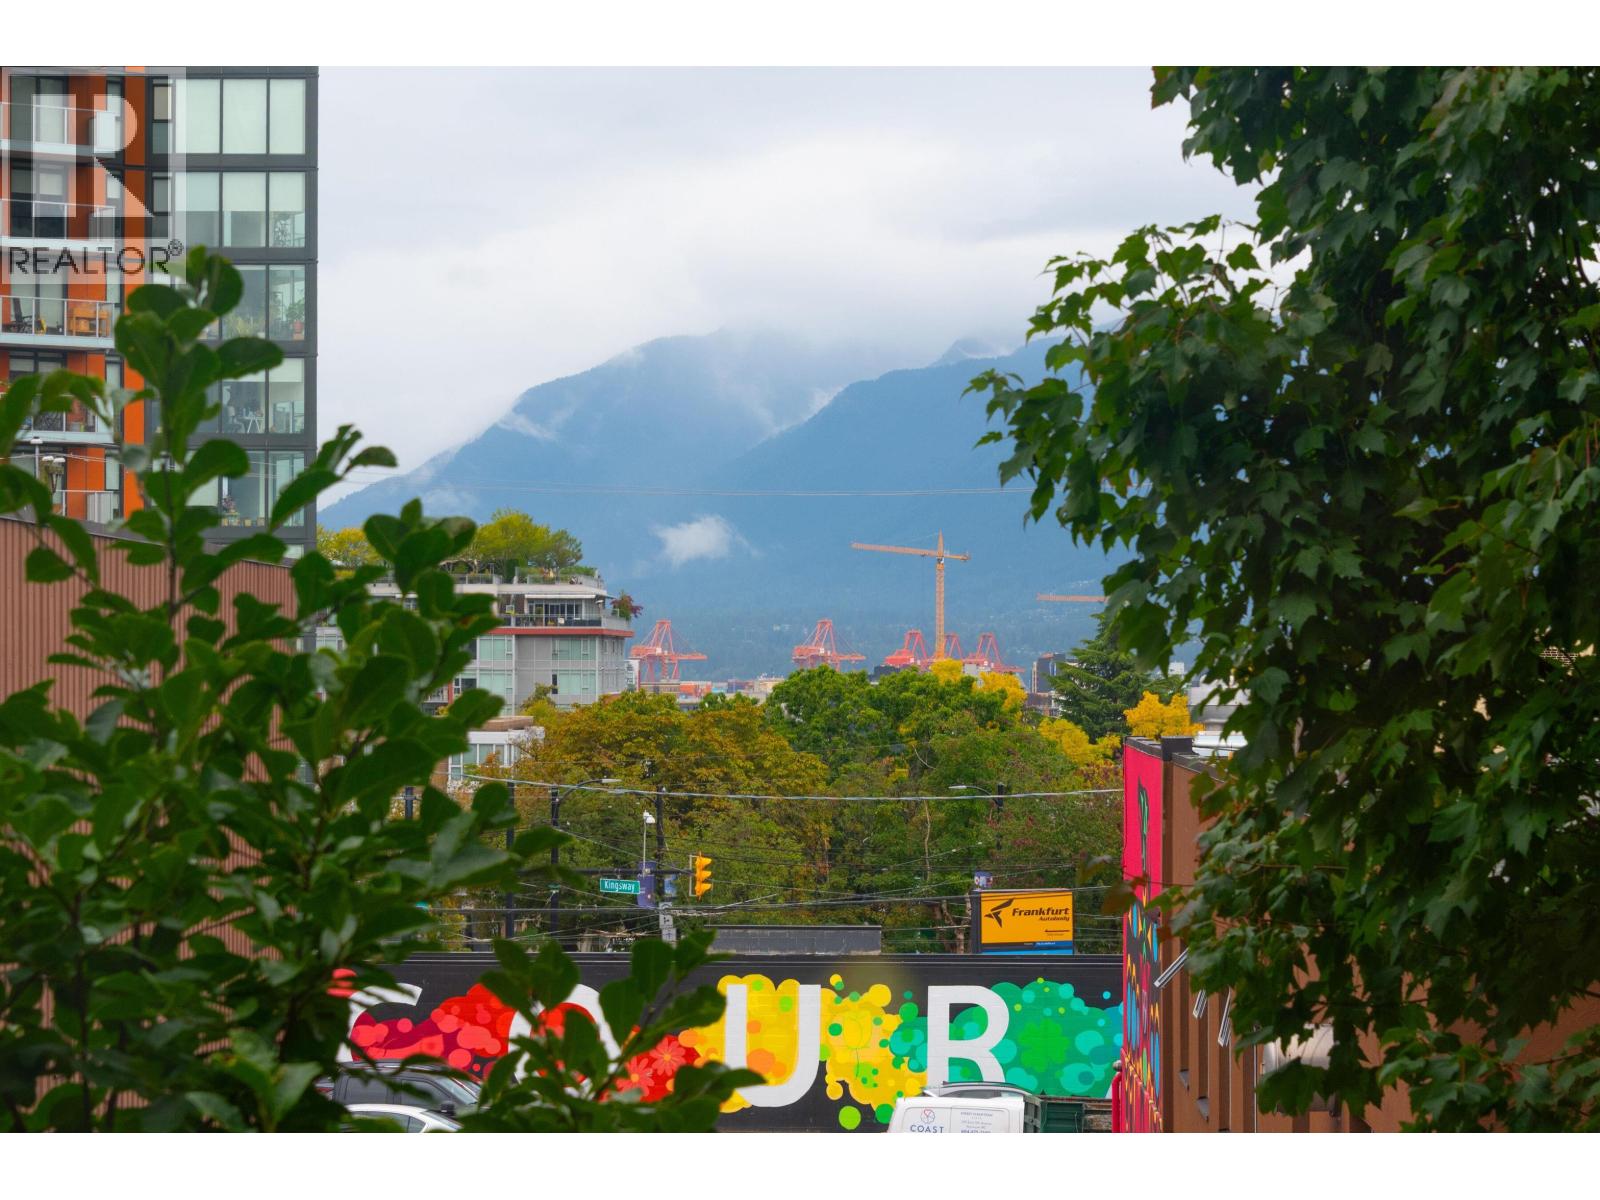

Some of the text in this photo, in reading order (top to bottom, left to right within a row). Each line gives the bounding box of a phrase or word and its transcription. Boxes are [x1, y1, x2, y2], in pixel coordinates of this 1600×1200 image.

[604, 881, 635, 893] Kingsway
[1012, 907, 1070, 916] Frankfurt
[910, 1124, 944, 1133] COAST
